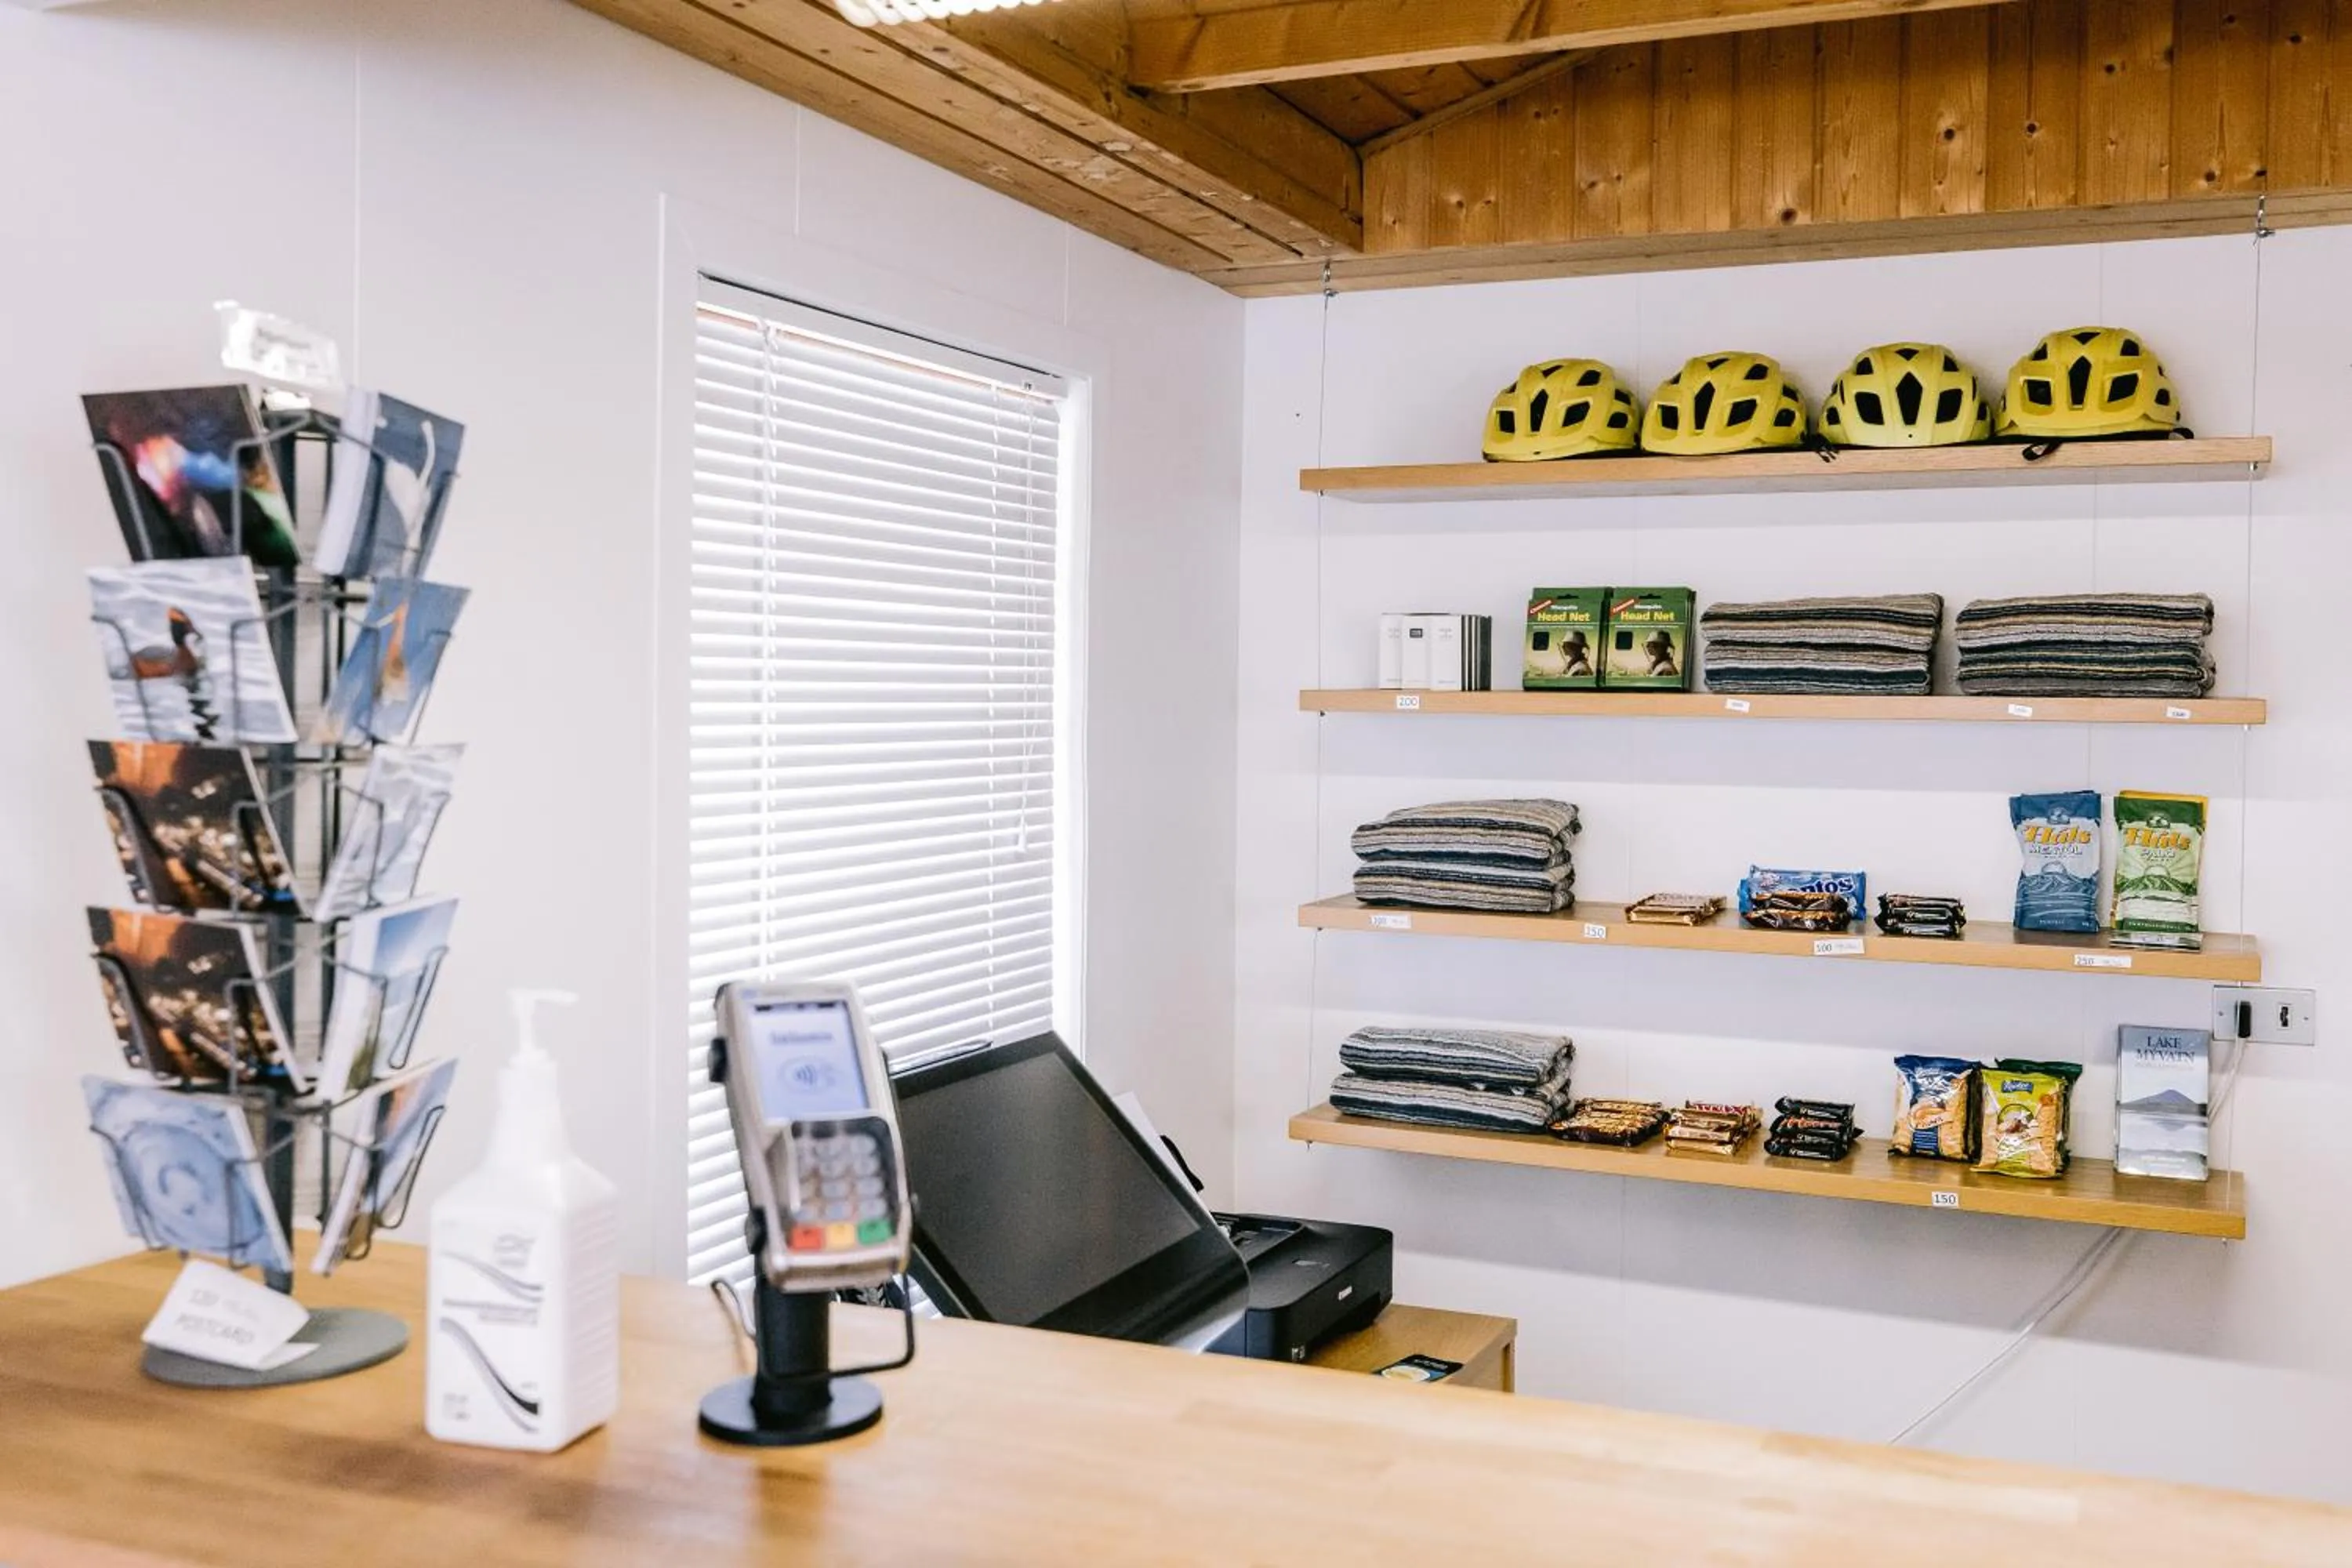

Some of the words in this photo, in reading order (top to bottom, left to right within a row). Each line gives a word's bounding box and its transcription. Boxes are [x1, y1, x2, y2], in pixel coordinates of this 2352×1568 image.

[1537, 611, 1566, 622] Head
[1569, 612, 1591, 622] Net
[1621, 611, 1650, 621] Head
[1653, 612, 1675, 622] Net
[2147, 1036, 2182, 1049] LAKE
[1934, 1194, 1956, 1204] 150
